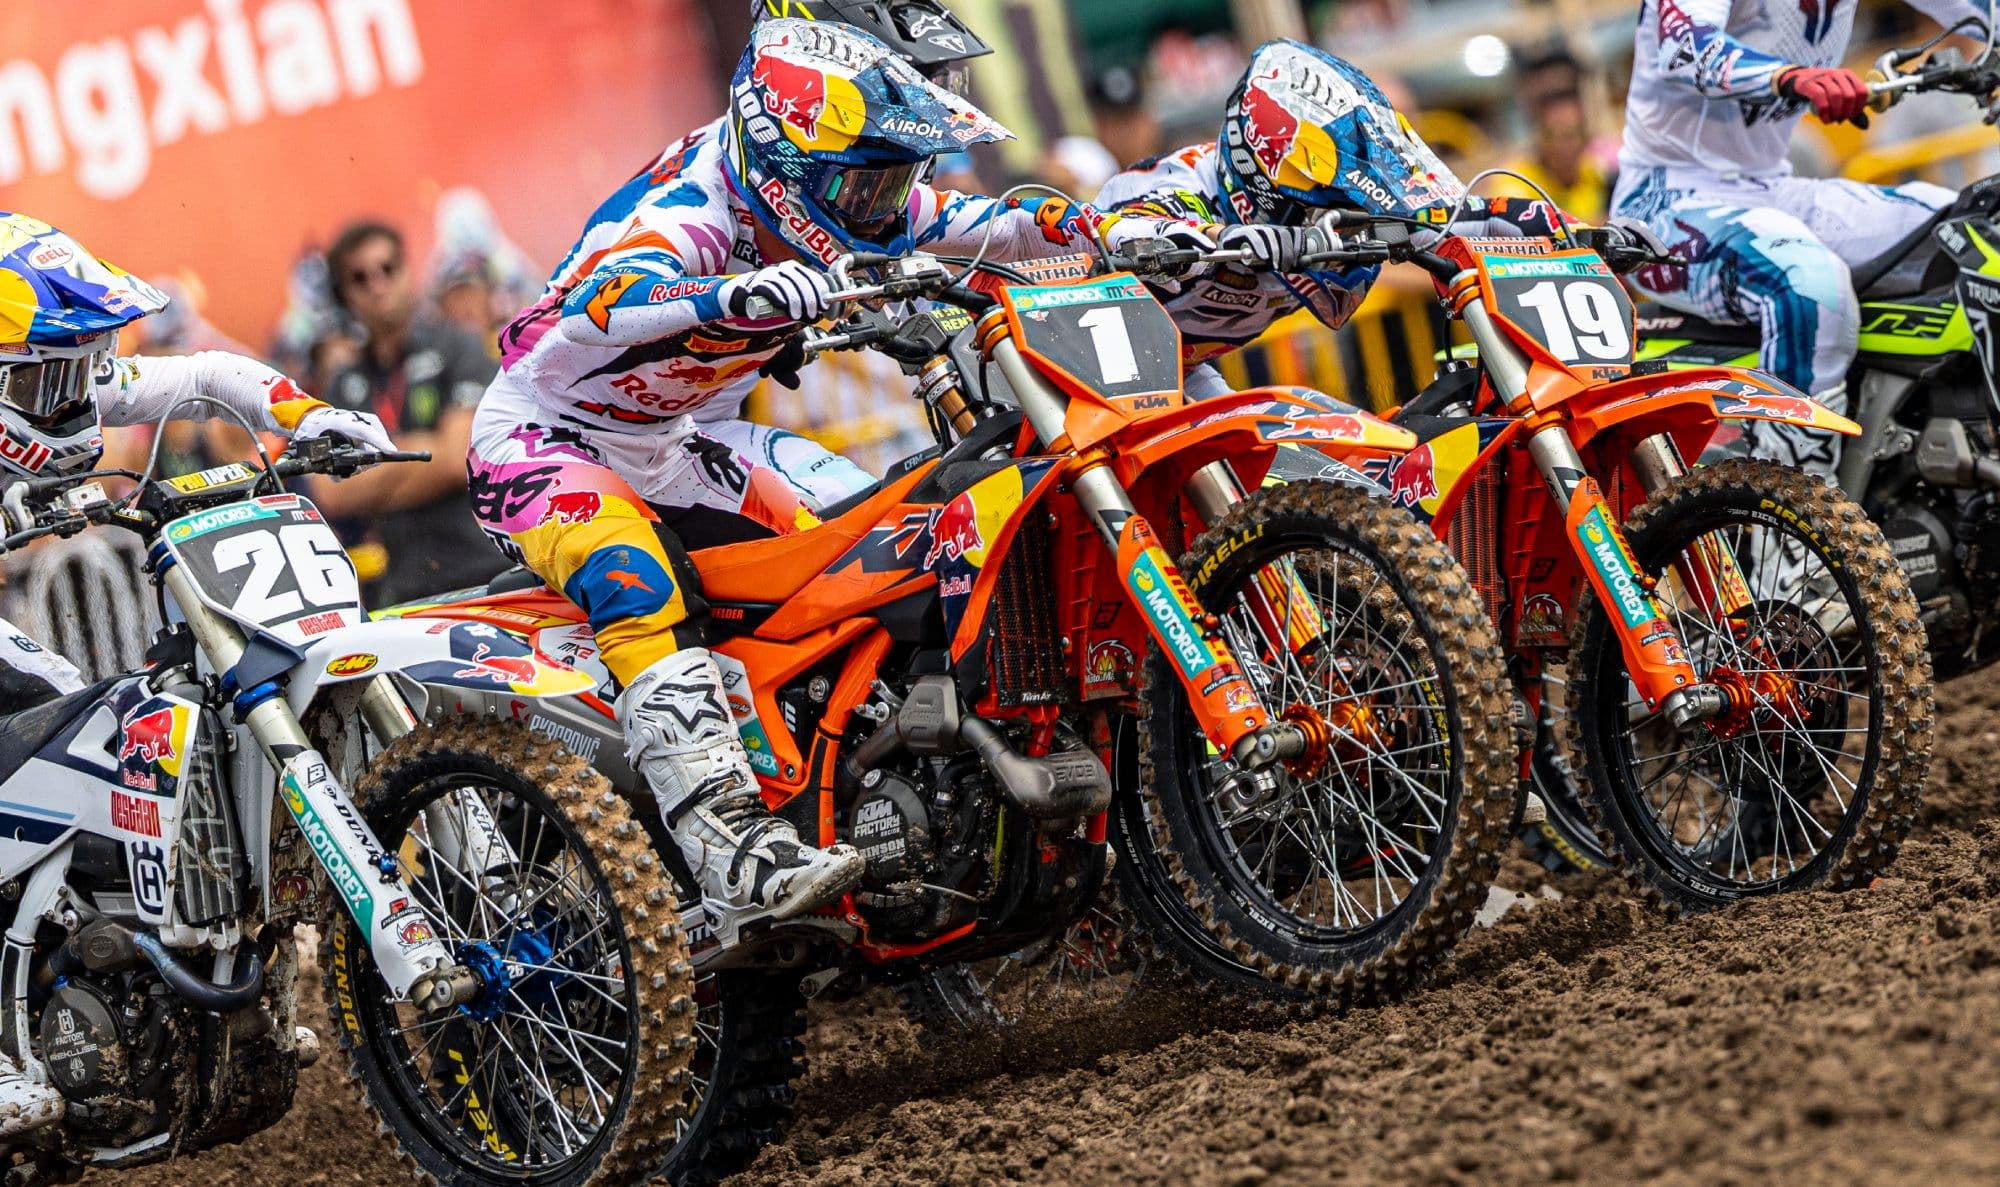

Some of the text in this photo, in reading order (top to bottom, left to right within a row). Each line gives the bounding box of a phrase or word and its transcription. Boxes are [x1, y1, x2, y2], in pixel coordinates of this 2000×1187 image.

[881, 118, 944, 139] AIROH
[820, 152, 850, 162] AIROH
[1346, 169, 1397, 211] AIROH
[760, 179, 841, 265] Red Bu
[36, 247, 70, 265] BELL
[1506, 262, 1571, 274] MOTOREX
[1034, 288, 1105, 306] MOTOREX
[1517, 281, 1630, 362] 19
[1078, 306, 1140, 385] 1
[1133, 395, 1170, 410] KTM
[191, 506, 257, 533] MOTOREX
[1751, 510, 1779, 526] EXCEL
[212, 523, 358, 622] 26
[1594, 541, 1649, 622] MOTOREX
[1146, 588, 1206, 672] MOTOREX
[327, 655, 376, 671] FMF
[123, 768, 157, 792] Red Bull
[857, 799, 893, 826] KTM
[854, 813, 900, 839] FACTORY
[300, 811, 369, 908] MOTOREX
[507, 964, 524, 980] 26
[55, 1030, 85, 1046] FACTORY
